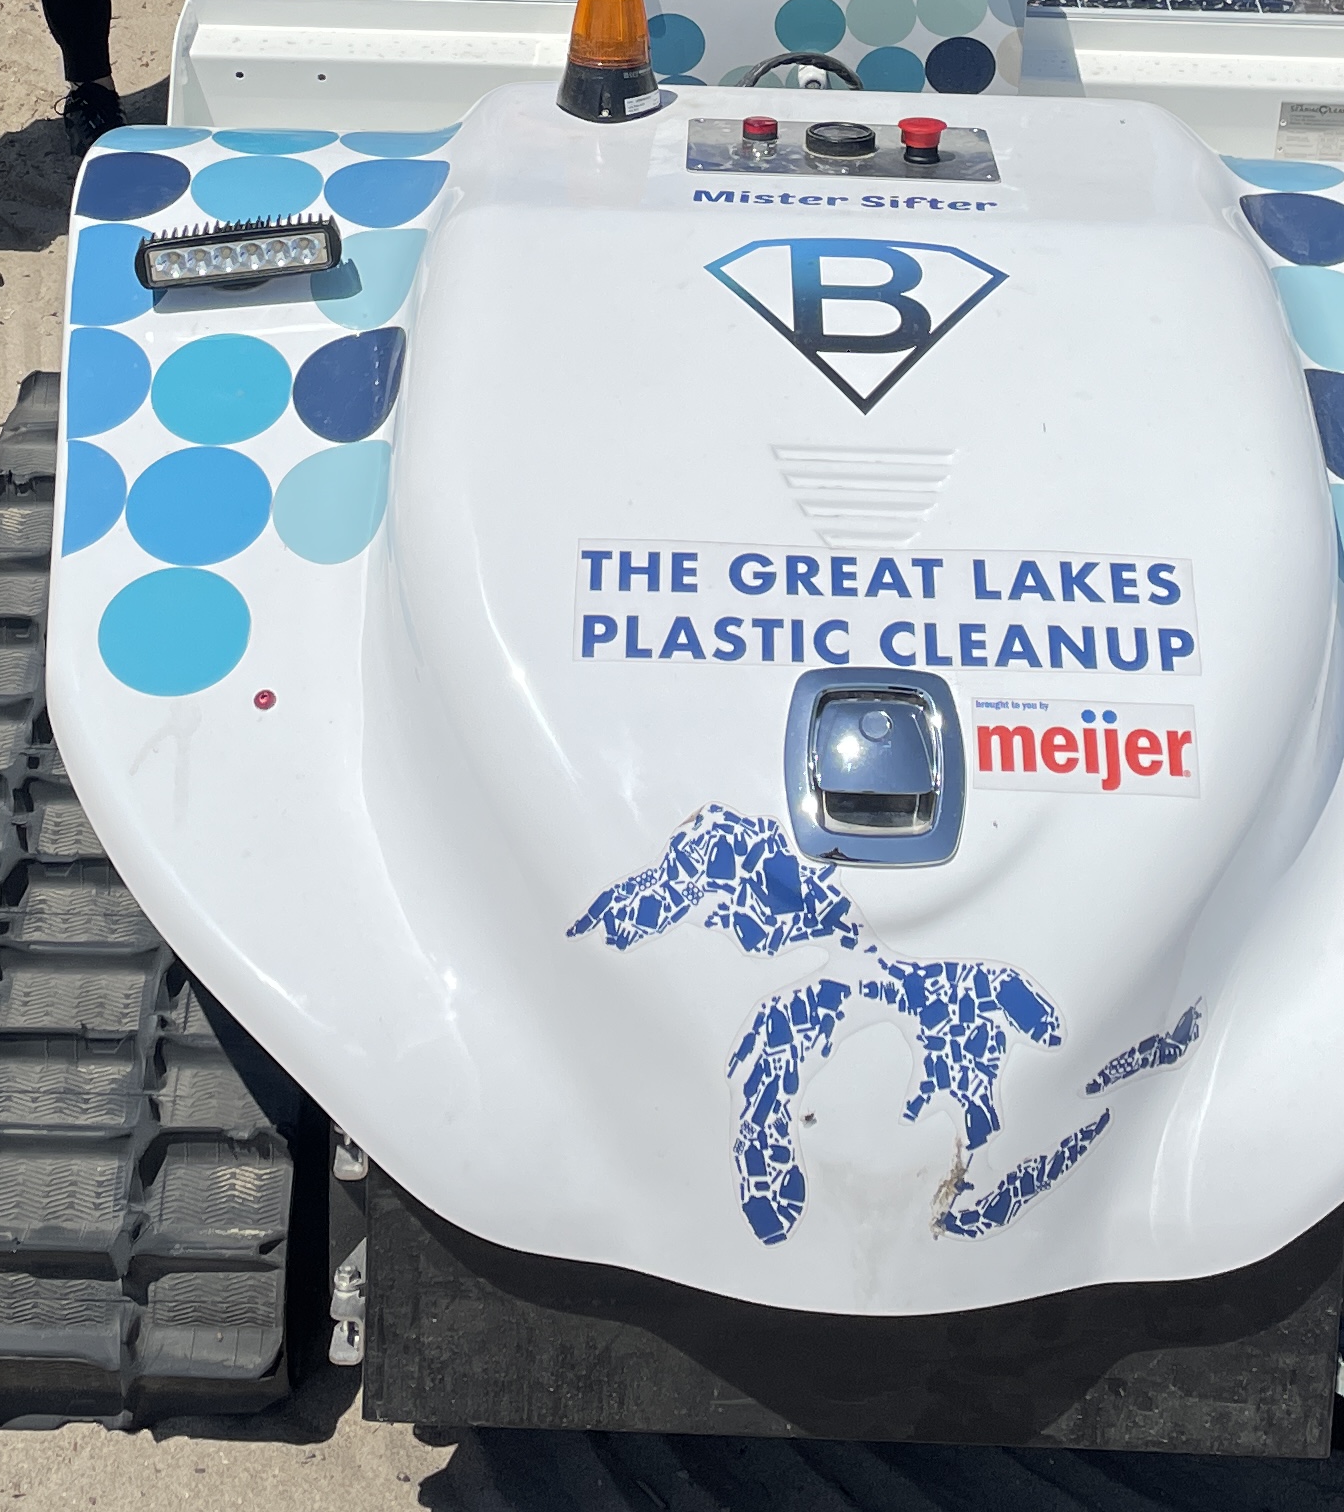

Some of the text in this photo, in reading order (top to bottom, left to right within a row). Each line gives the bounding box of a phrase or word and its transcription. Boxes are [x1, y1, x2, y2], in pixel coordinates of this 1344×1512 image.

[693, 190, 998, 212] Mister Sifter
[581, 550, 1182, 606] THE GREAT LAKES
[581, 614, 1195, 672] PLASTIC CLEANUP
[975, 699, 1049, 712] brought to you by
[976, 709, 1193, 791] meijer
